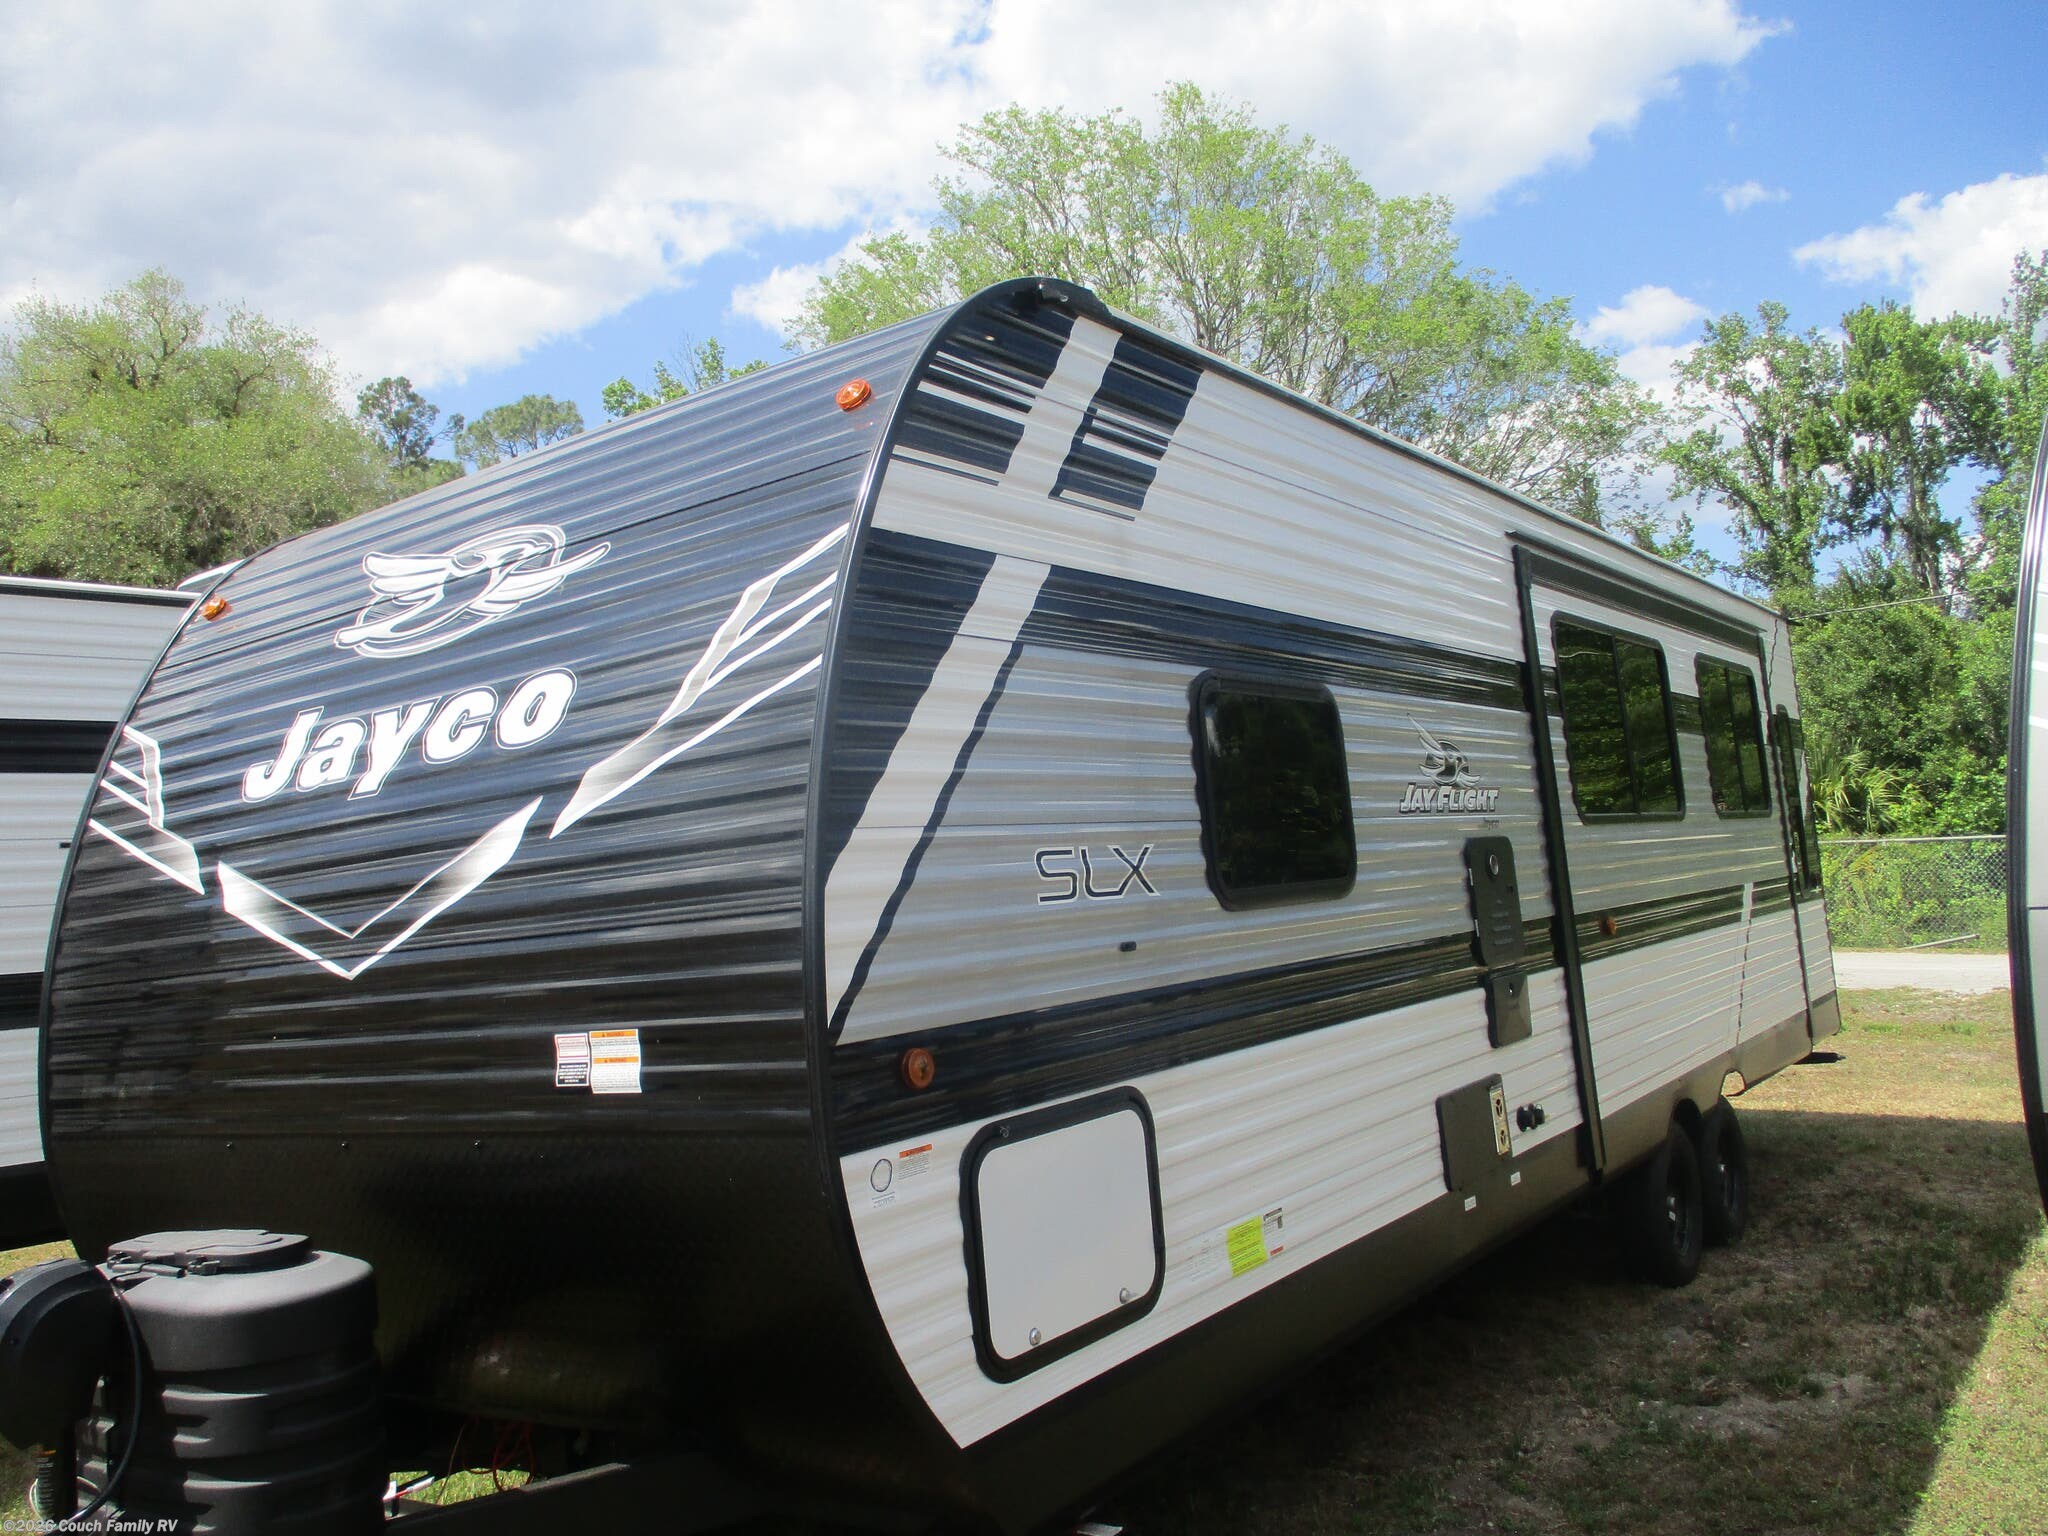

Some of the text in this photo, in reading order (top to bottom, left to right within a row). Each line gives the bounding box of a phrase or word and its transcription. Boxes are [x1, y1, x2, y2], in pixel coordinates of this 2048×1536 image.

[241, 667, 577, 803] Jayco
[1399, 782, 1499, 814] JAY FLIGHT
[1034, 844, 1160, 905] SLX
